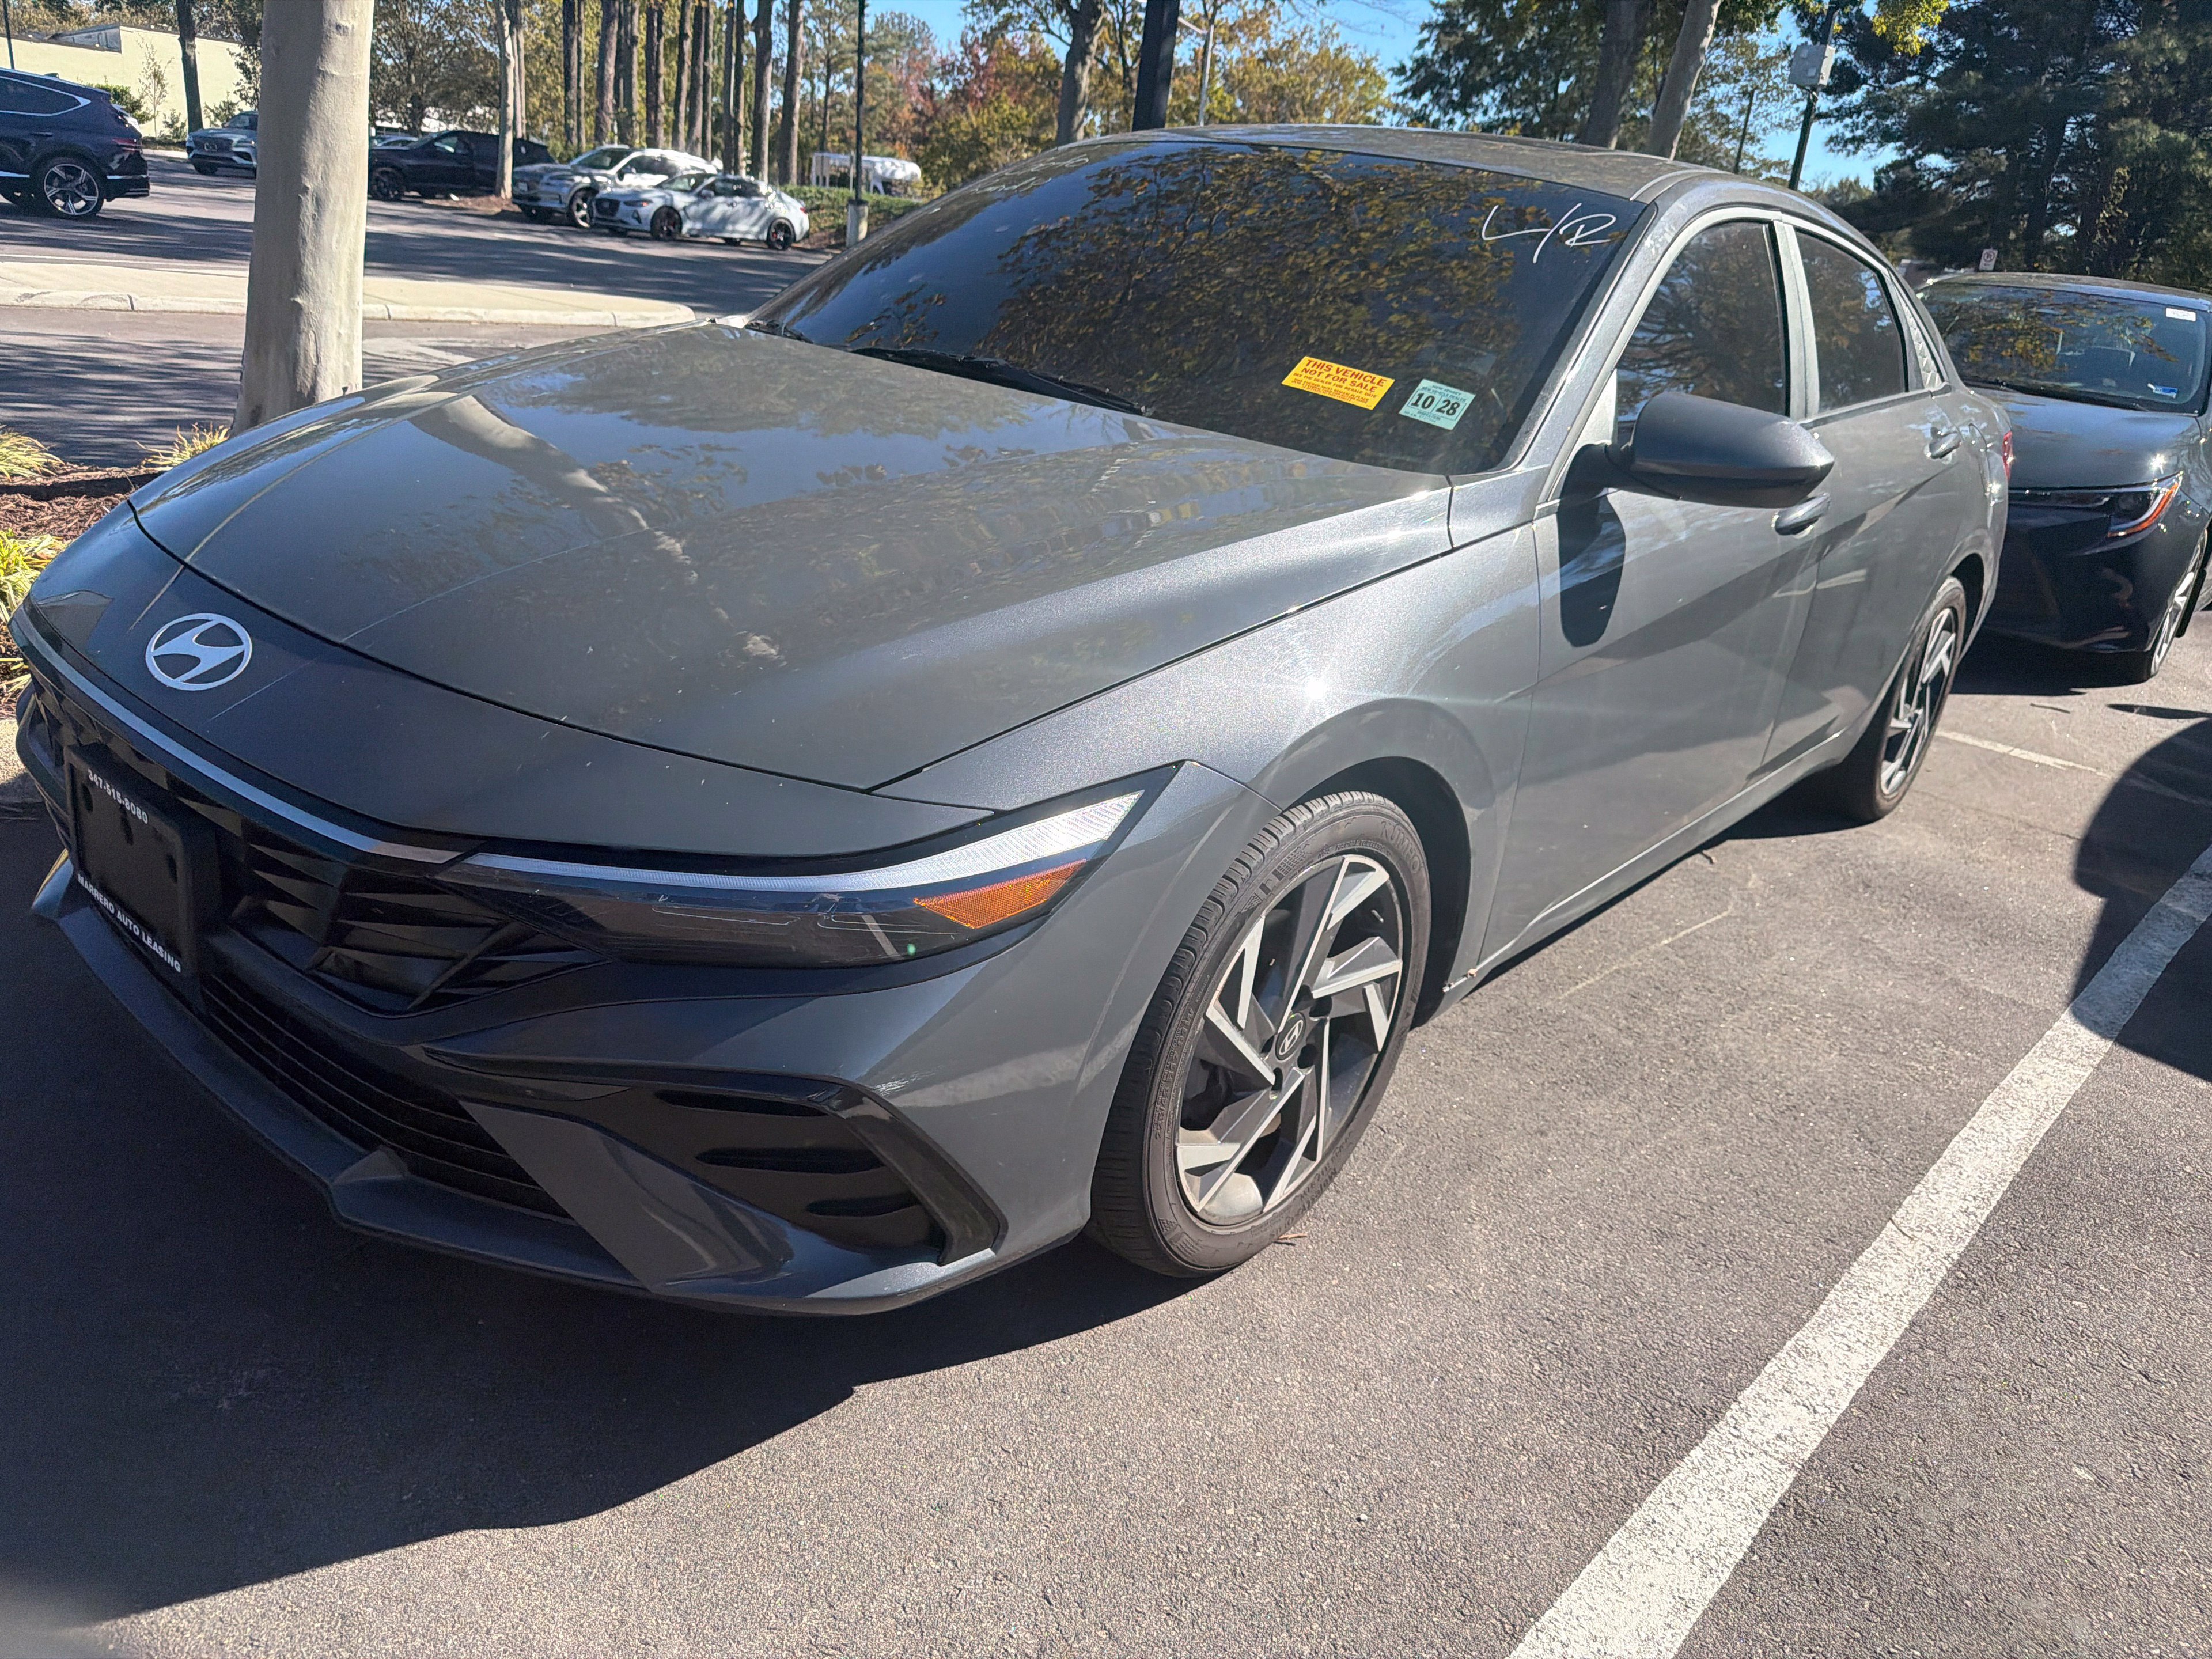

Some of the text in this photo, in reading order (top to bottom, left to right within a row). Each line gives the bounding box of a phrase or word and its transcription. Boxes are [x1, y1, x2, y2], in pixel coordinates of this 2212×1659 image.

[1301, 368, 1377, 392] NOT FOR SALE
[1306, 359, 1387, 387] THIS VEHICLE
[1411, 392, 1460, 416] 10 28
[78, 873, 181, 973] MARRERO AUTO LEASING
